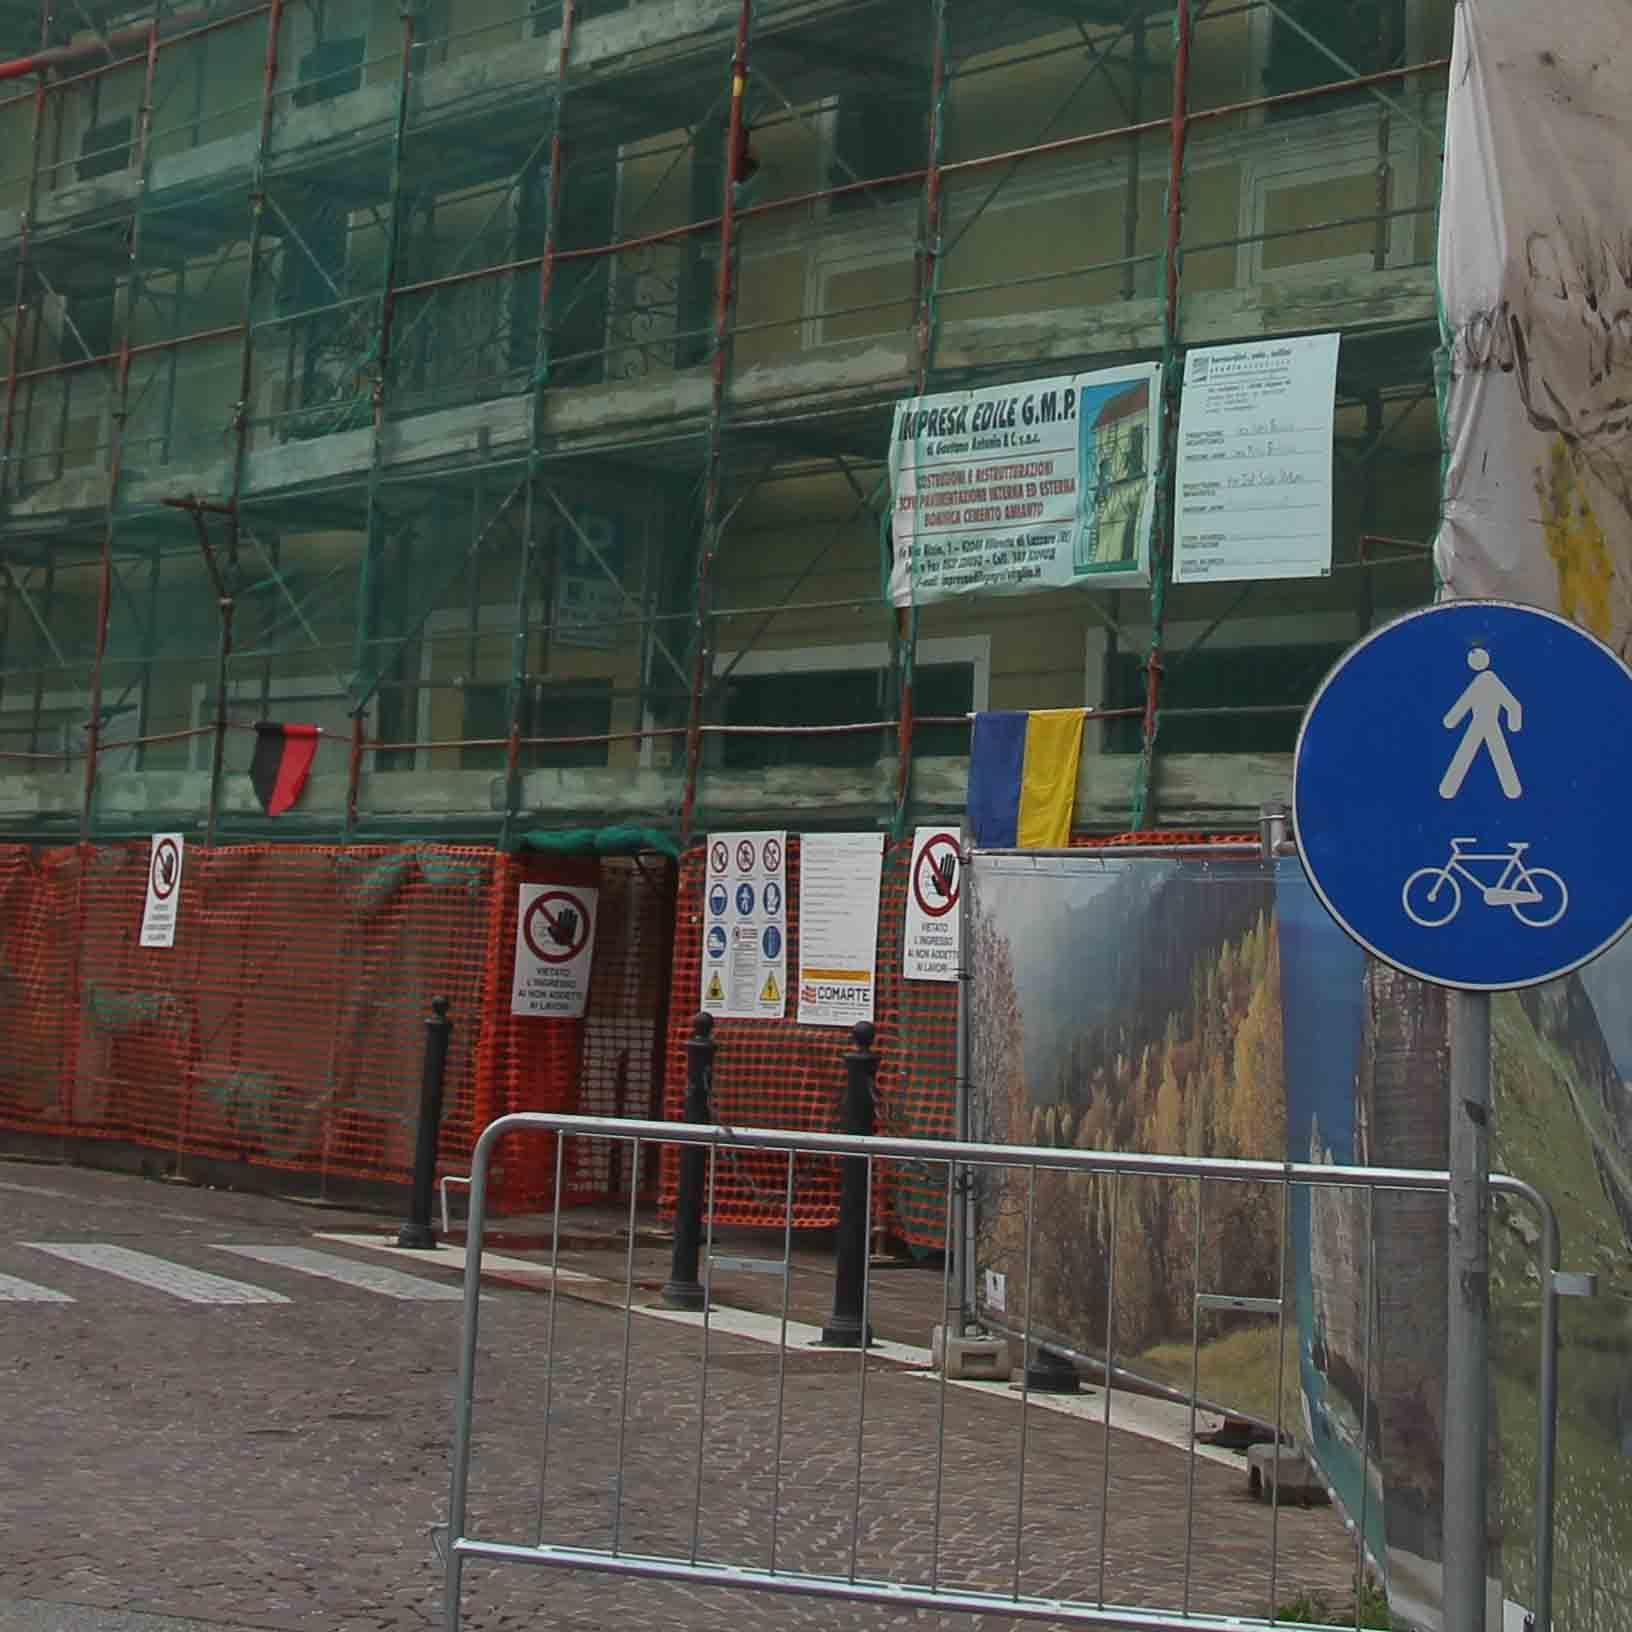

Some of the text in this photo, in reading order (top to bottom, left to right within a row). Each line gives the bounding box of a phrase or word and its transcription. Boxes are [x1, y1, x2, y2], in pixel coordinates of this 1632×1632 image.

[898, 388, 1076, 441] IMPRESA EDILE G.M.P.
[817, 985, 872, 1003] COMARTE
